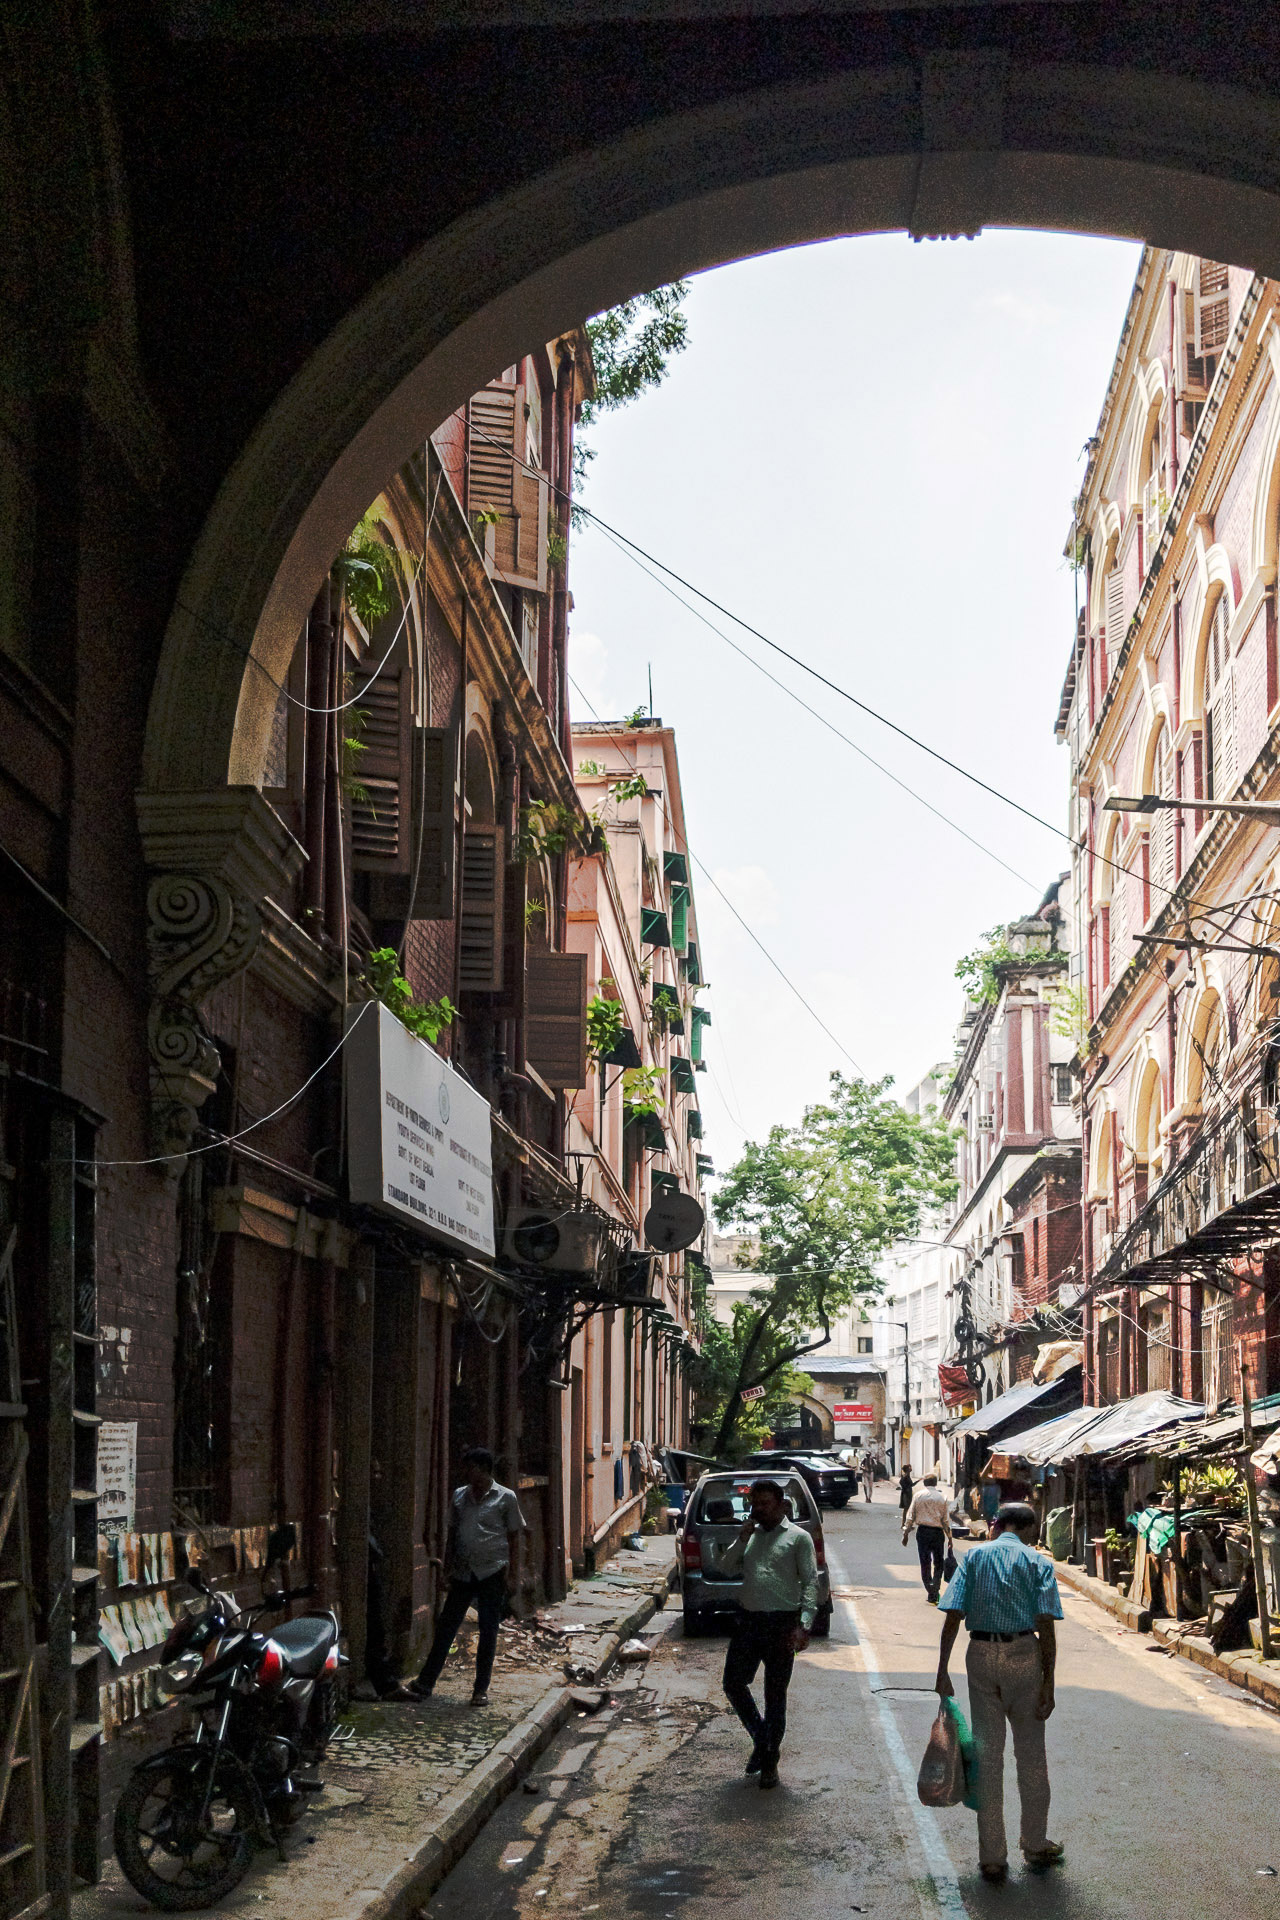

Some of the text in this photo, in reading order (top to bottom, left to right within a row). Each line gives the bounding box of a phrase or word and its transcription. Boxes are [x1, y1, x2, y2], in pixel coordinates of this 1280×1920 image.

[397, 1121, 409, 1140] YOUTH
[410, 1130, 425, 1151] SERVICES
[388, 1183, 408, 1206] STANDARD
